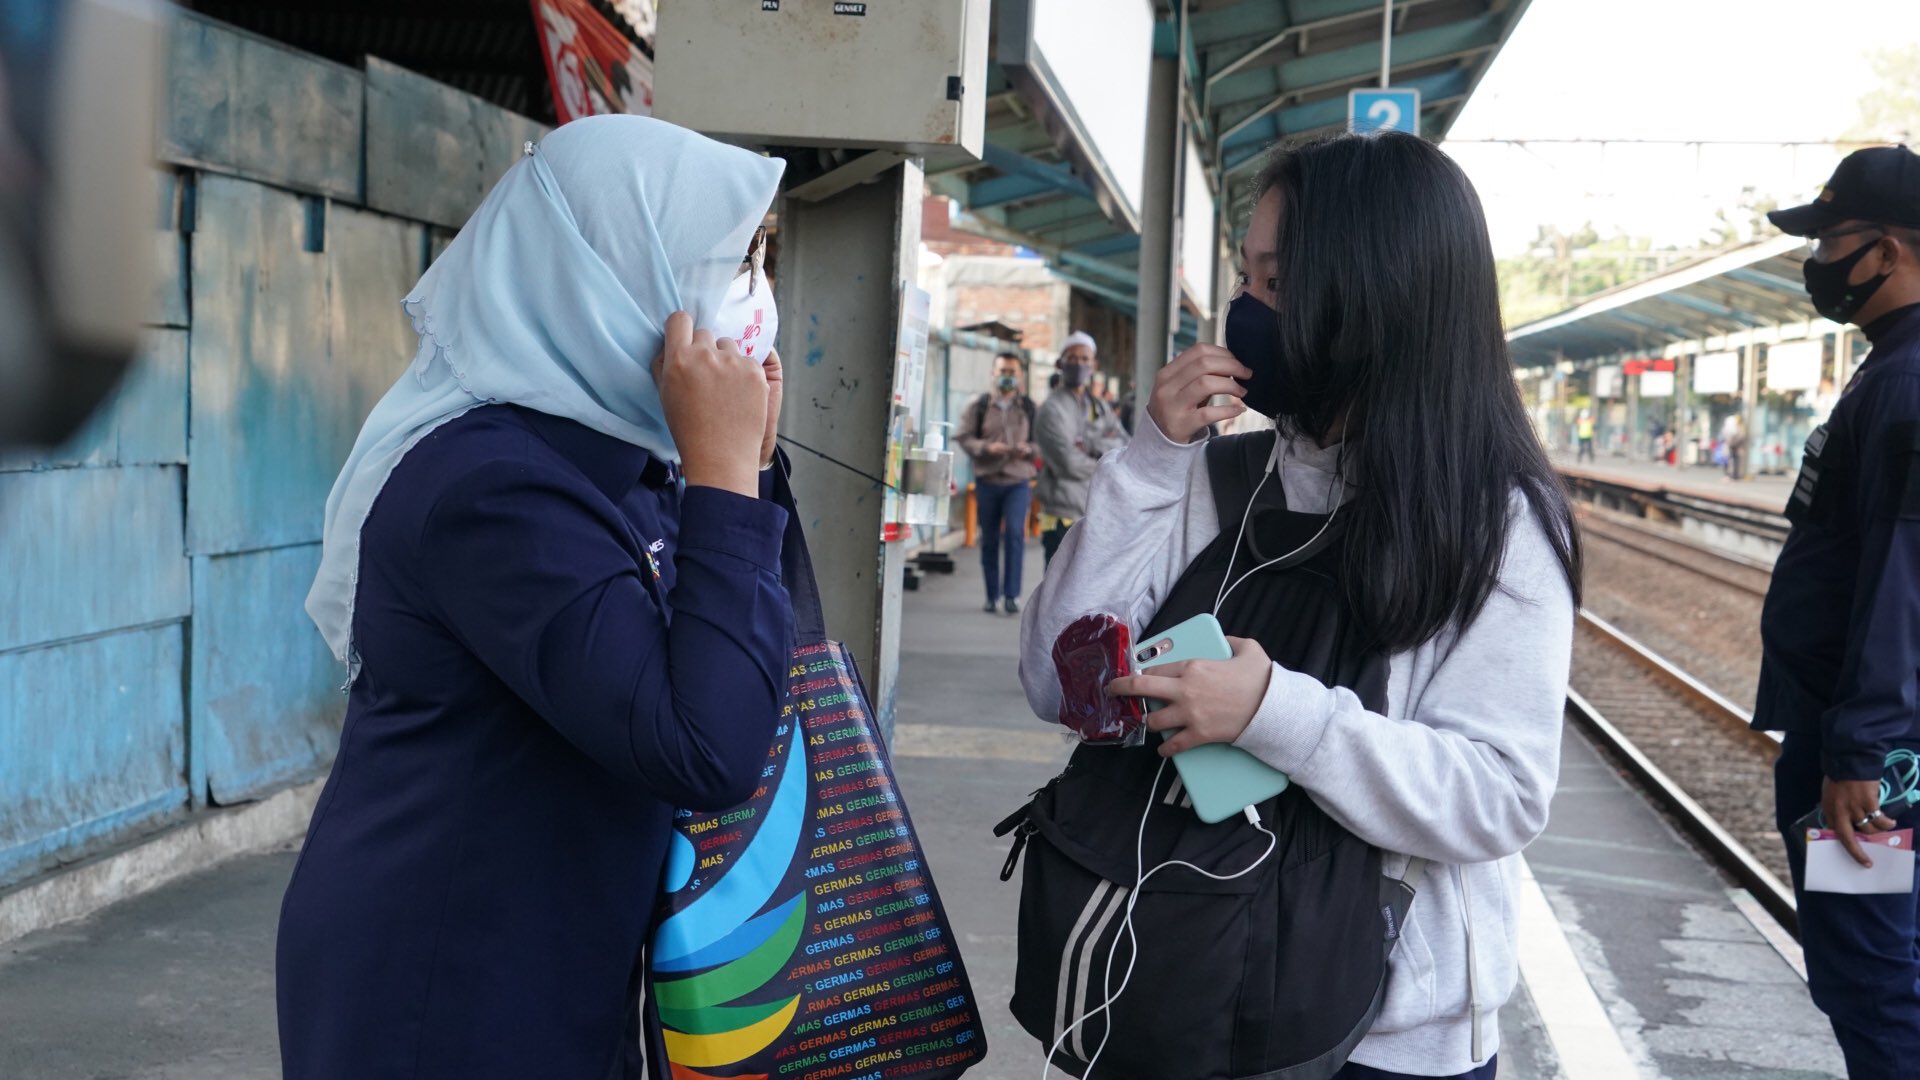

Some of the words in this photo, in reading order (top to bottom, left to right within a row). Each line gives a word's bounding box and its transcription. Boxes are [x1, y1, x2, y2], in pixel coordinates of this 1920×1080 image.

[834, 4, 863, 12] GENSET
[1368, 99, 1401, 132] 2
[791, 677, 837, 695] GERMAS
[805, 711, 846, 728] ERMAS
[836, 760, 875, 777] GERMAS
[818, 780, 864, 799] GERMAS
[846, 794, 886, 812] GERMAS
[684, 818, 719, 834] RMAS
[828, 815, 874, 835] GERMAS
[810, 839, 854, 859] ERMAS
[856, 828, 896, 846] GERMAS
[699, 854, 724, 870] MAS
[838, 850, 883, 870] GERMAS
[814, 874, 863, 896] GERMAS
[865, 863, 904, 882] GERMAS
[847, 885, 893, 906] GERMAS
[824, 909, 873, 931] GERMAS
[875, 897, 915, 917] GERMAS
[805, 933, 855, 955] GERMAS
[856, 920, 902, 942] GERMAS
[787, 959, 831, 981] ERMAS
[834, 945, 882, 967] GERMAS
[884, 931, 925, 953] GERMAS
[815, 969, 864, 991] GERMAS
[866, 956, 912, 977] GERMAS
[805, 993, 841, 1014] RMAS
[843, 980, 891, 1003] GERMAS
[893, 967, 935, 988] GERMAS
[793, 1019, 821, 1035] MAS
[824, 1004, 871, 1026] GERMAS
[874, 991, 921, 1011] GERMAS
[922, 977, 960, 998] GERMAS
[799, 1029, 848, 1051] GERMAS
[850, 1015, 897, 1036] GERMAS
[900, 1002, 946, 1023] GERMAS
[779, 1053, 827, 1074] GERMAS
[829, 1037, 876, 1059] GERMAS
[879, 1027, 928, 1046] GERMAS
[931, 1012, 971, 1033] GERMAS
[804, 1063, 852, 1080] GERMAS
[855, 1049, 903, 1070] GERMAS
[905, 1037, 954, 1056] GERMAS
[884, 1060, 933, 1077] GERMAS
